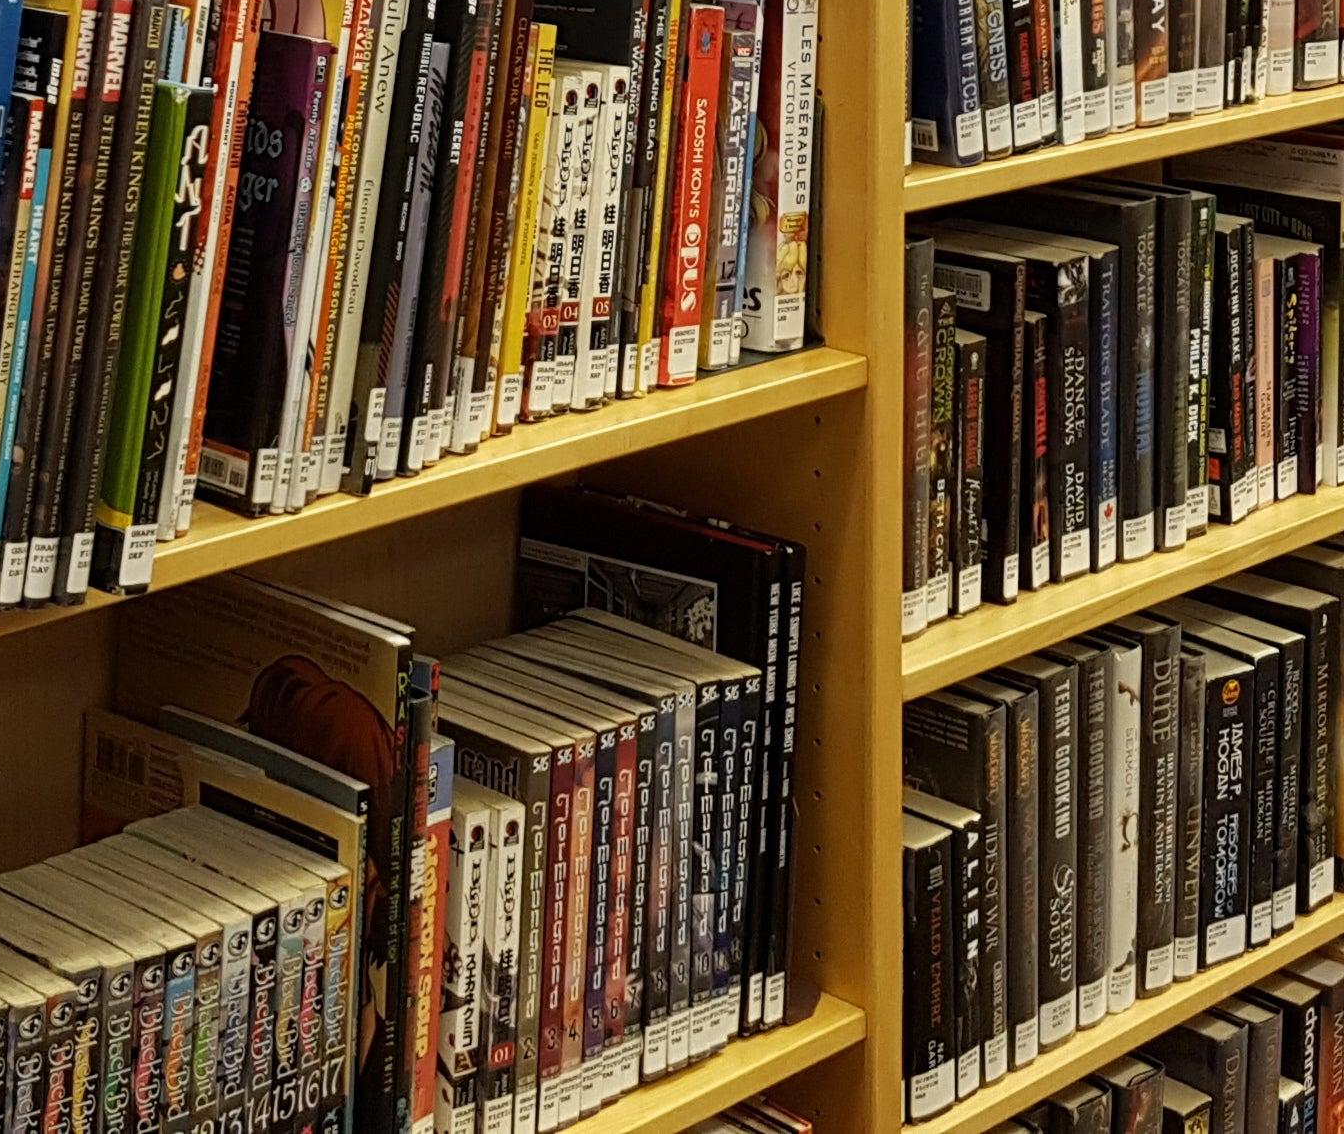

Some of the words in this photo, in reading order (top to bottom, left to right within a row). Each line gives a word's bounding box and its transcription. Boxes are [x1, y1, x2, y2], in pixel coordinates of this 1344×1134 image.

[655, 7, 667, 37] THE
[798, 24, 815, 63] LES
[987, 9, 1006, 83] GNEISS
[416, 33, 433, 74] INVISIBLE
[649, 41, 665, 113] WALKING
[131, 59, 157, 144] STEPHEN
[372, 57, 398, 114] Anew
[409, 76, 427, 144] REPUBLIC
[785, 61, 797, 125] VICTOR
[645, 118, 657, 161] DEAD
[691, 98, 708, 163] SATOSHI
[725, 79, 742, 152] LAST
[794, 72, 813, 205] MISÉRABLES
[22, 109, 43, 200] MARVEL
[124, 150, 147, 213] KING'S
[783, 133, 796, 184] HUGO
[357, 179, 375, 234] Étienne
[688, 167, 705, 219] KON'S
[721, 159, 739, 247] ORDER
[27, 204, 44, 265] HEART
[5, 229, 28, 330] NORTHANGER
[345, 240, 368, 316] Davodeau
[1230, 248, 1240, 312] JOCELYNN
[1189, 328, 1201, 379] PHILIP
[1231, 317, 1241, 363] DRAKE
[1063, 346, 1076, 446] SHADOWS
[1189, 384, 1199, 400] K.
[1187, 405, 1199, 443] DICK
[790, 581, 801, 601] LIKE
[790, 604, 800, 613] A
[786, 615, 800, 652] SNIPER
[784, 655, 797, 688] LINING
[784, 690, 796, 705] UP
[783, 708, 795, 723] HIS
[1055, 680, 1071, 739] TERRY
[782, 727, 794, 754] SHOT
[1055, 745, 1071, 839] GOODKIND
[966, 831, 981, 962] ALIEN
